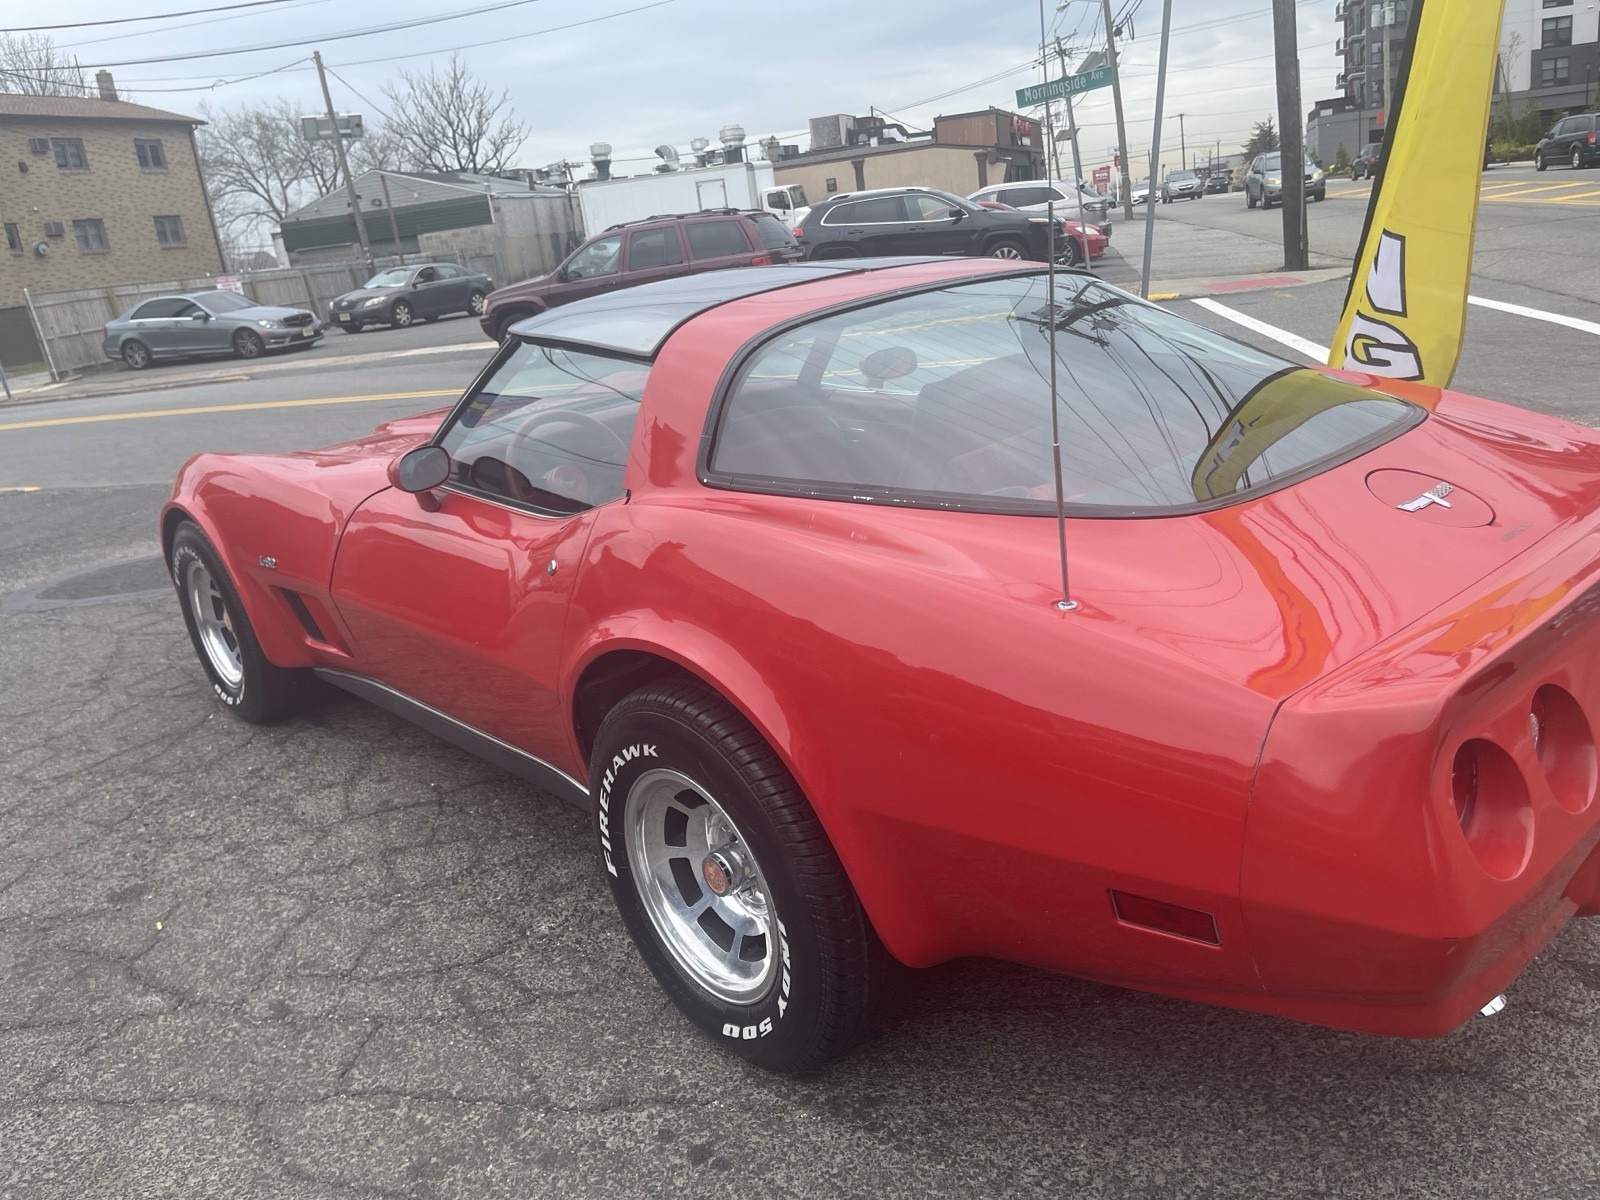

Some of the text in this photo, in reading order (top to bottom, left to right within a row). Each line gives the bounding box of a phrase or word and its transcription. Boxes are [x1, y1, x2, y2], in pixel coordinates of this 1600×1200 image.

[1024, 71, 1104, 102] Morningside Ave
[599, 744, 792, 1040] FIREHAWK INDY 500
